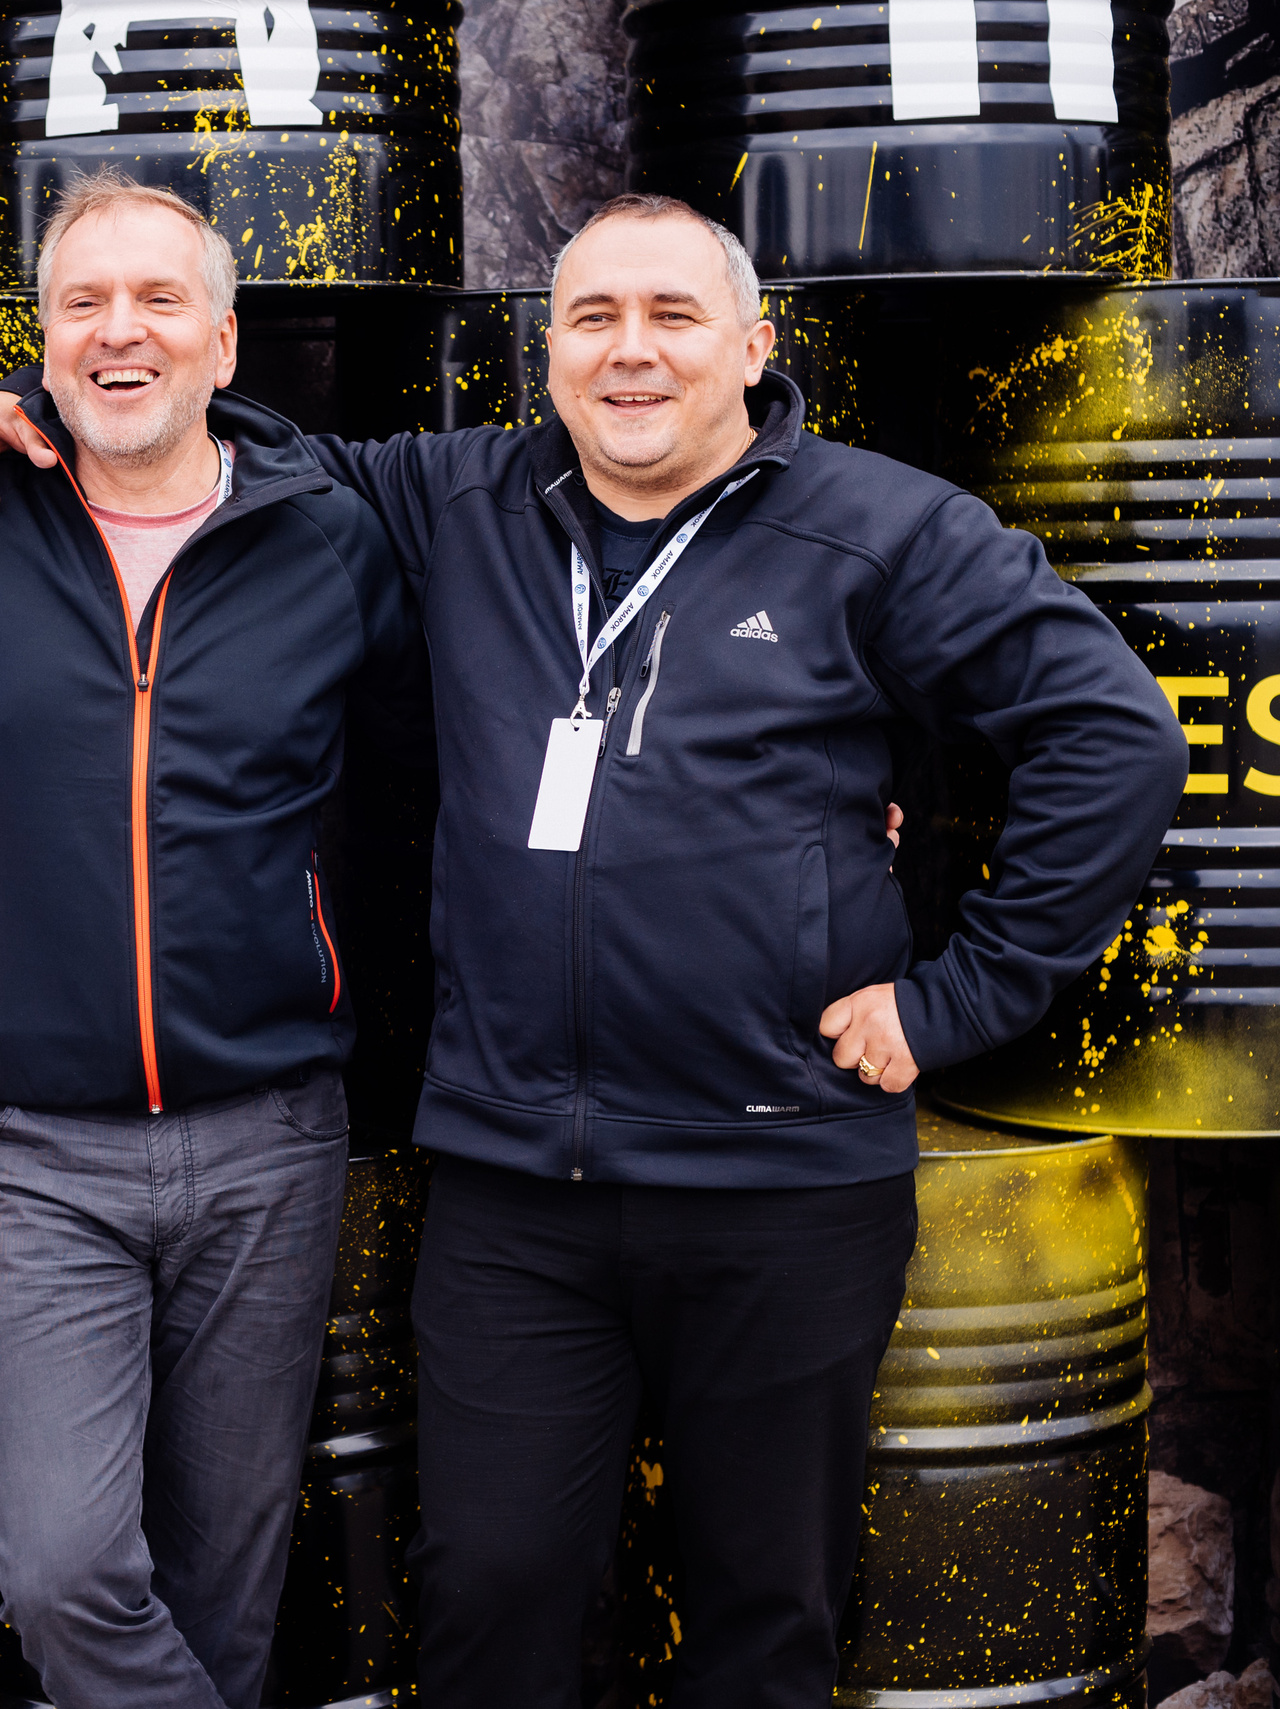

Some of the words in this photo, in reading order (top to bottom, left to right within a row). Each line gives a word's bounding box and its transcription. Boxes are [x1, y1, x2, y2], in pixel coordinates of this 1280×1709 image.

[651, 550, 674, 580] AMAROK
[610, 602, 634, 632] AMAROK
[730, 626, 779, 643] adidas
[305, 869, 314, 908] MUSTO
[311, 923, 327, 983] EVOLUTION
